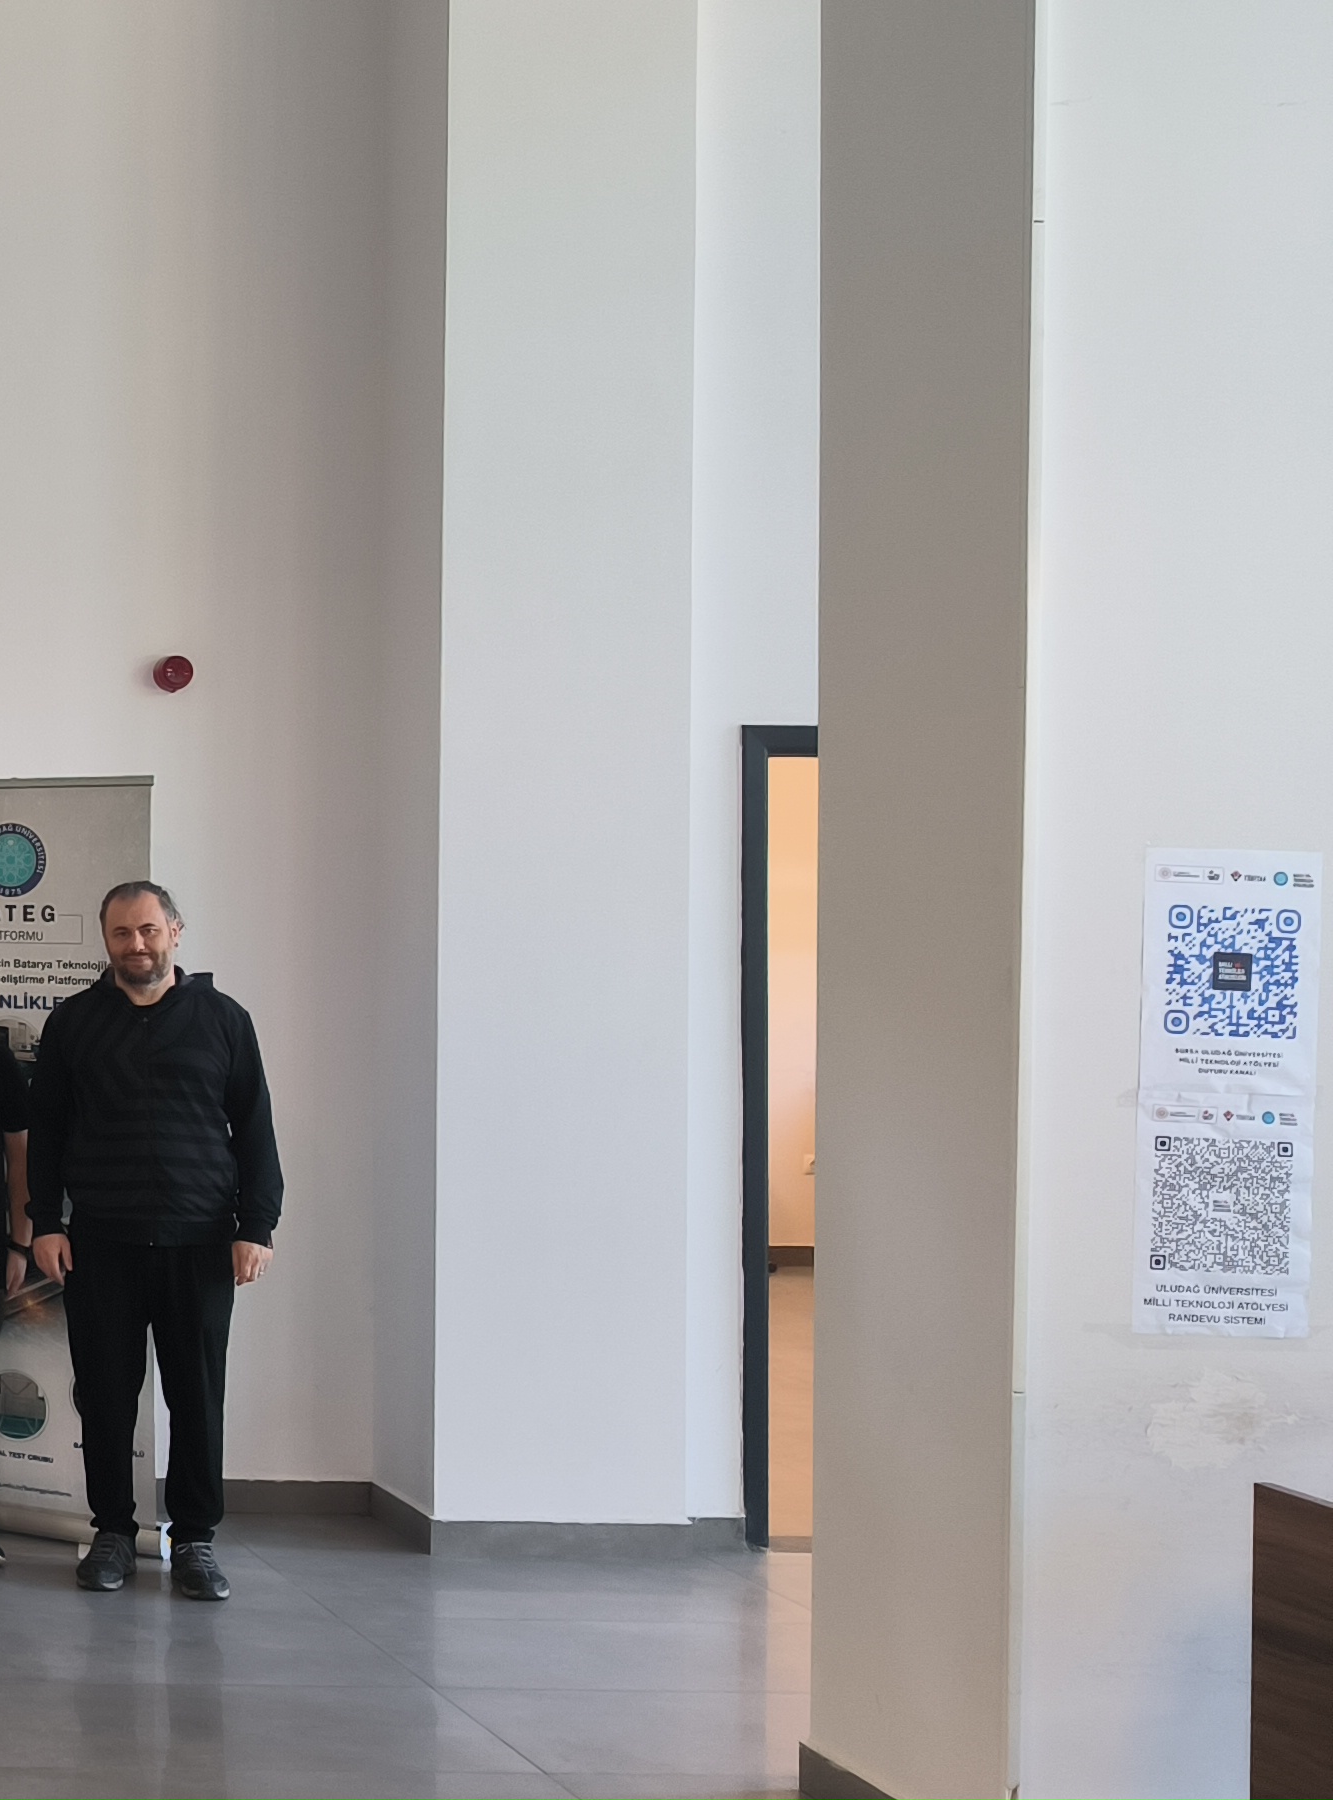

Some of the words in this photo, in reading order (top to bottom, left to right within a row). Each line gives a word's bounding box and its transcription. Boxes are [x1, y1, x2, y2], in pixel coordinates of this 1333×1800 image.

[13, 958, 53, 971] Batarya
[1155, 1283, 1201, 1295] ULUDAĞ
[1203, 1284, 1278, 1297] ÜNİVERSİTESİ
[1174, 1298, 1235, 1310] TEKNOLOJİ
[1236, 1300, 1289, 1312] ATÖLYESİ
[1168, 1312, 1221, 1324] RANDEVU
[1223, 1314, 1266, 1326] SİSTEMİ
